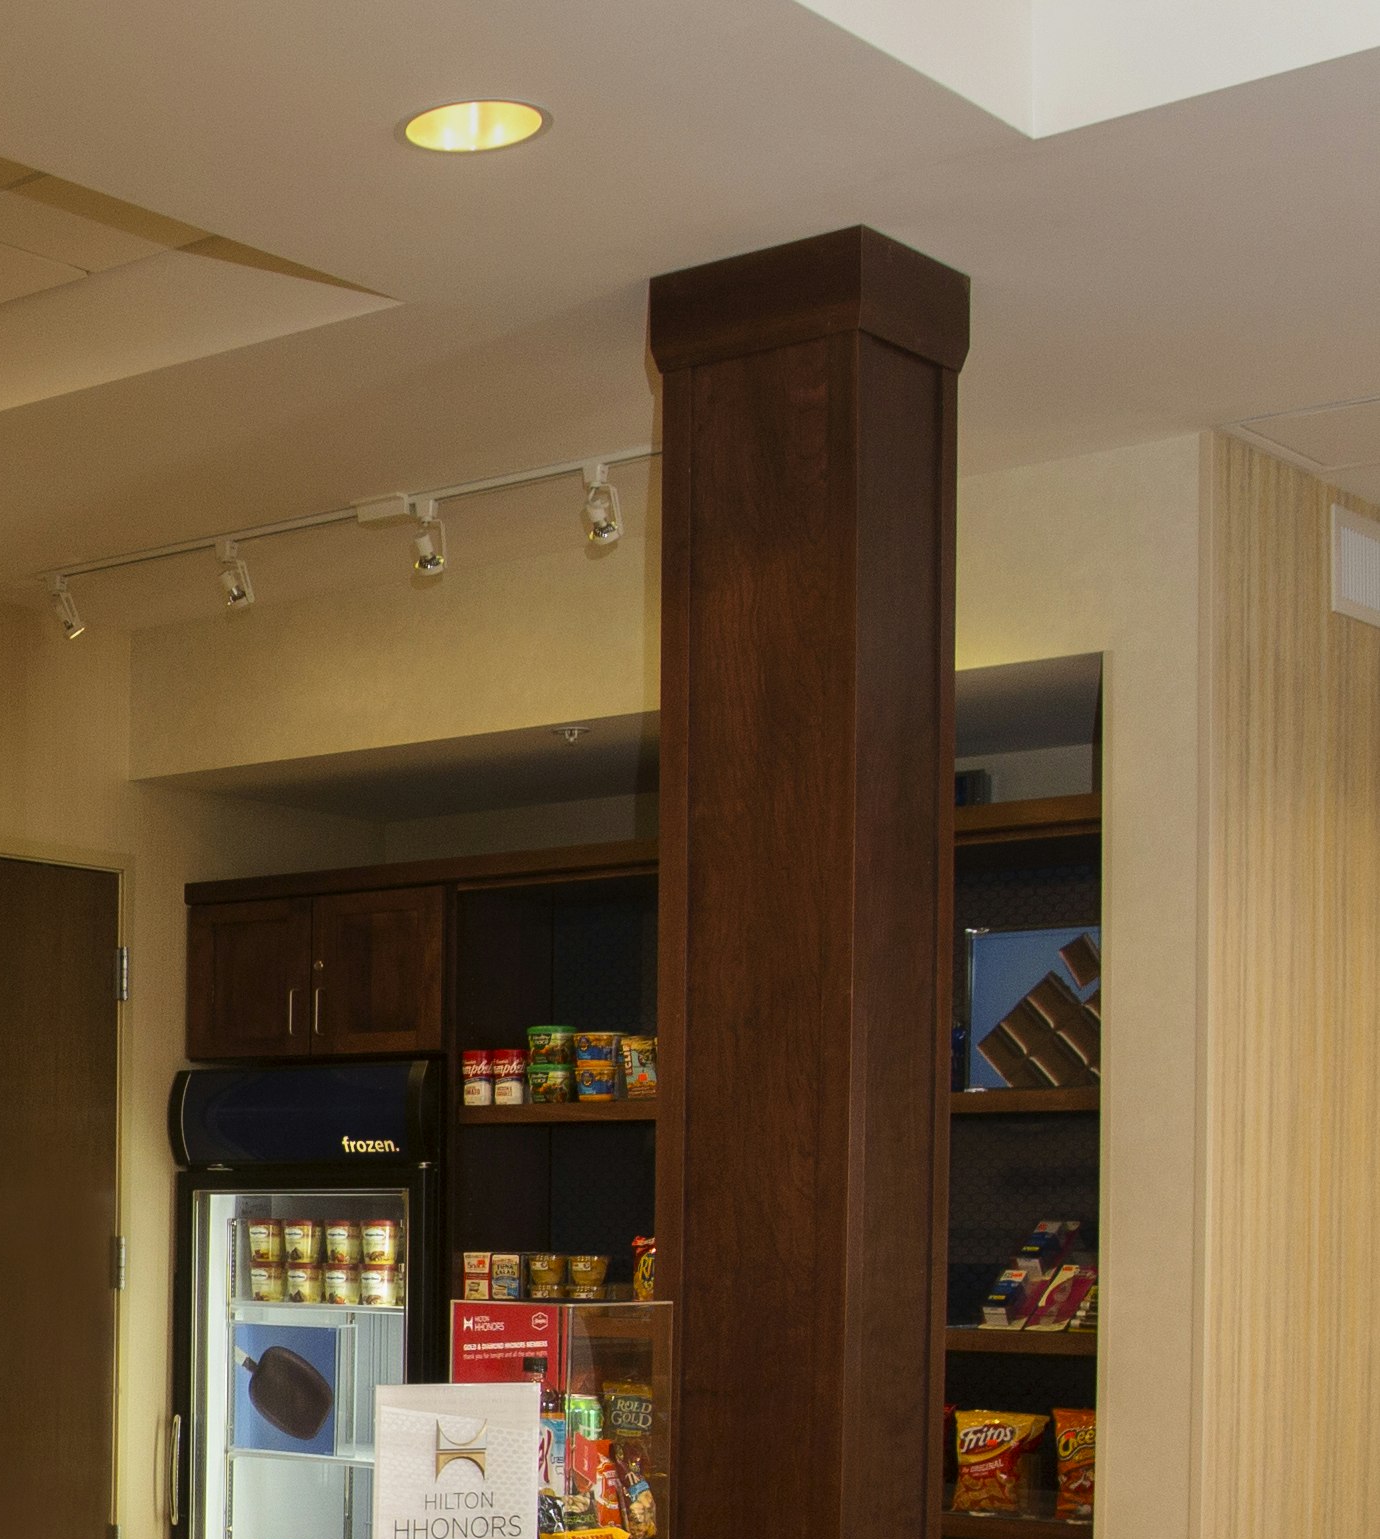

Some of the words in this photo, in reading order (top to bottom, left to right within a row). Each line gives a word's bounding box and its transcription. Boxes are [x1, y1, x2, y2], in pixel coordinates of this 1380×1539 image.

[342, 1136, 400, 1153] frozen.
[616, 1399, 652, 1413] ROLD
[610, 1411, 653, 1428] GOLD
[960, 1424, 1014, 1452] Fritos
[970, 1460, 1004, 1473] ORIGINAL
[425, 1492, 494, 1510] HILTON
